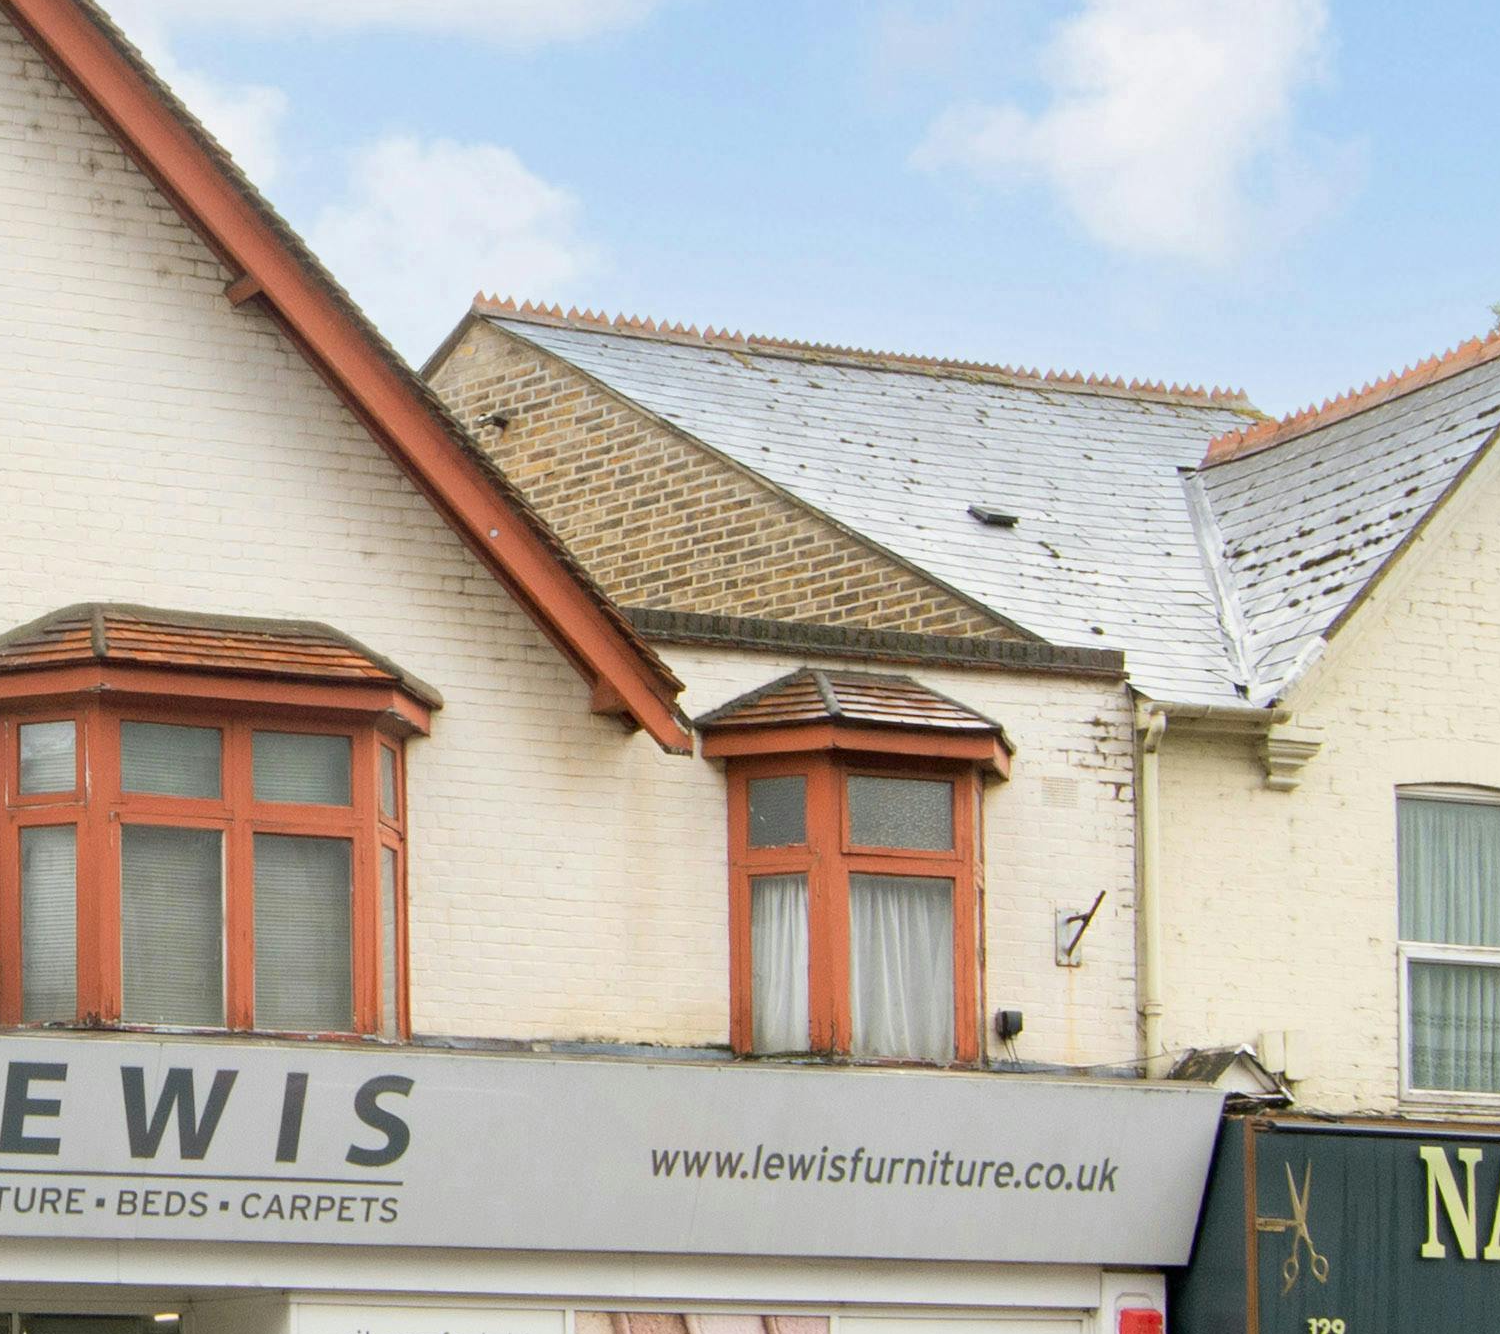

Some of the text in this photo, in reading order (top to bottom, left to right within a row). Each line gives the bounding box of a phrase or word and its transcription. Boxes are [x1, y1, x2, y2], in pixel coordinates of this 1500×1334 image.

[650, 1144, 1118, 1192] www.lewisfurniture.co.uk
[116, 1192, 208, 1218] BEDS
[240, 1194, 399, 1223] CARPETS
